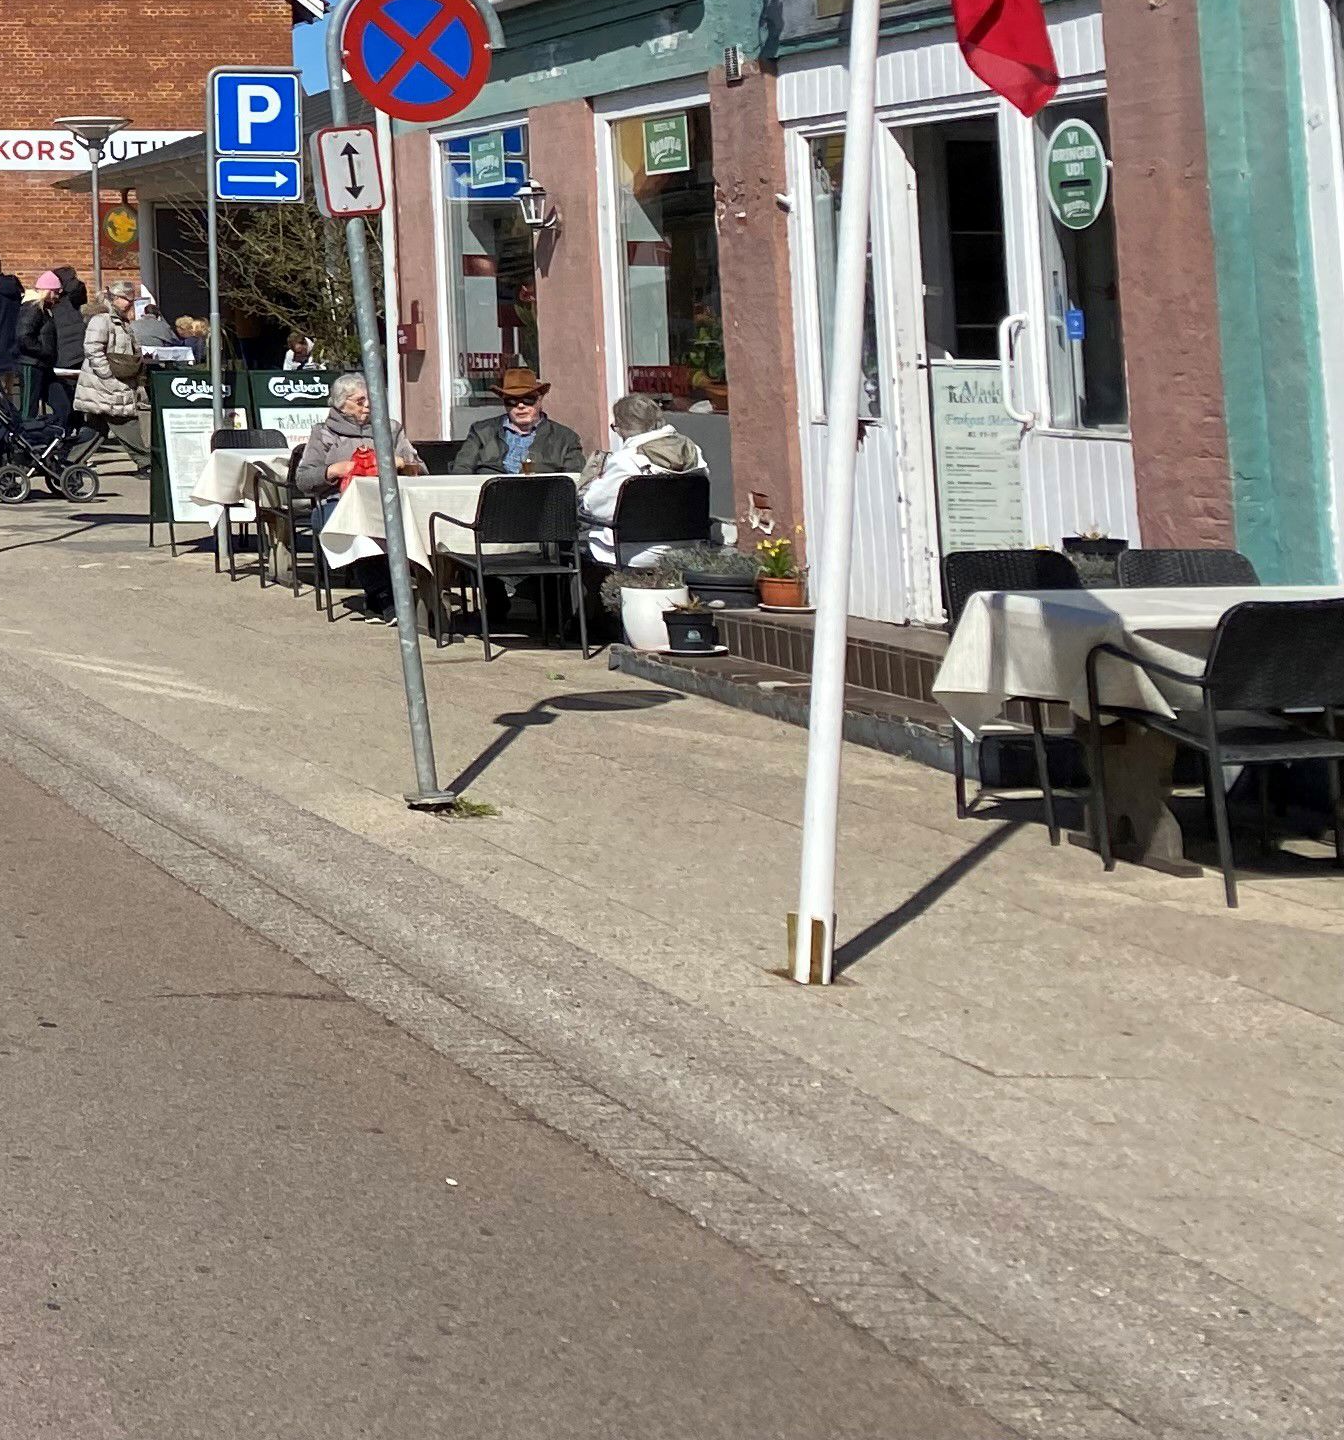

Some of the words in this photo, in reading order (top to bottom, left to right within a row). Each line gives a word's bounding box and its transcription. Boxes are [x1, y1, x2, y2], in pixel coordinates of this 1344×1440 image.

[238, 84, 282, 144] P
[171, 377, 232, 399] Carlsbeg
[268, 376, 330, 399] Carlsberg
